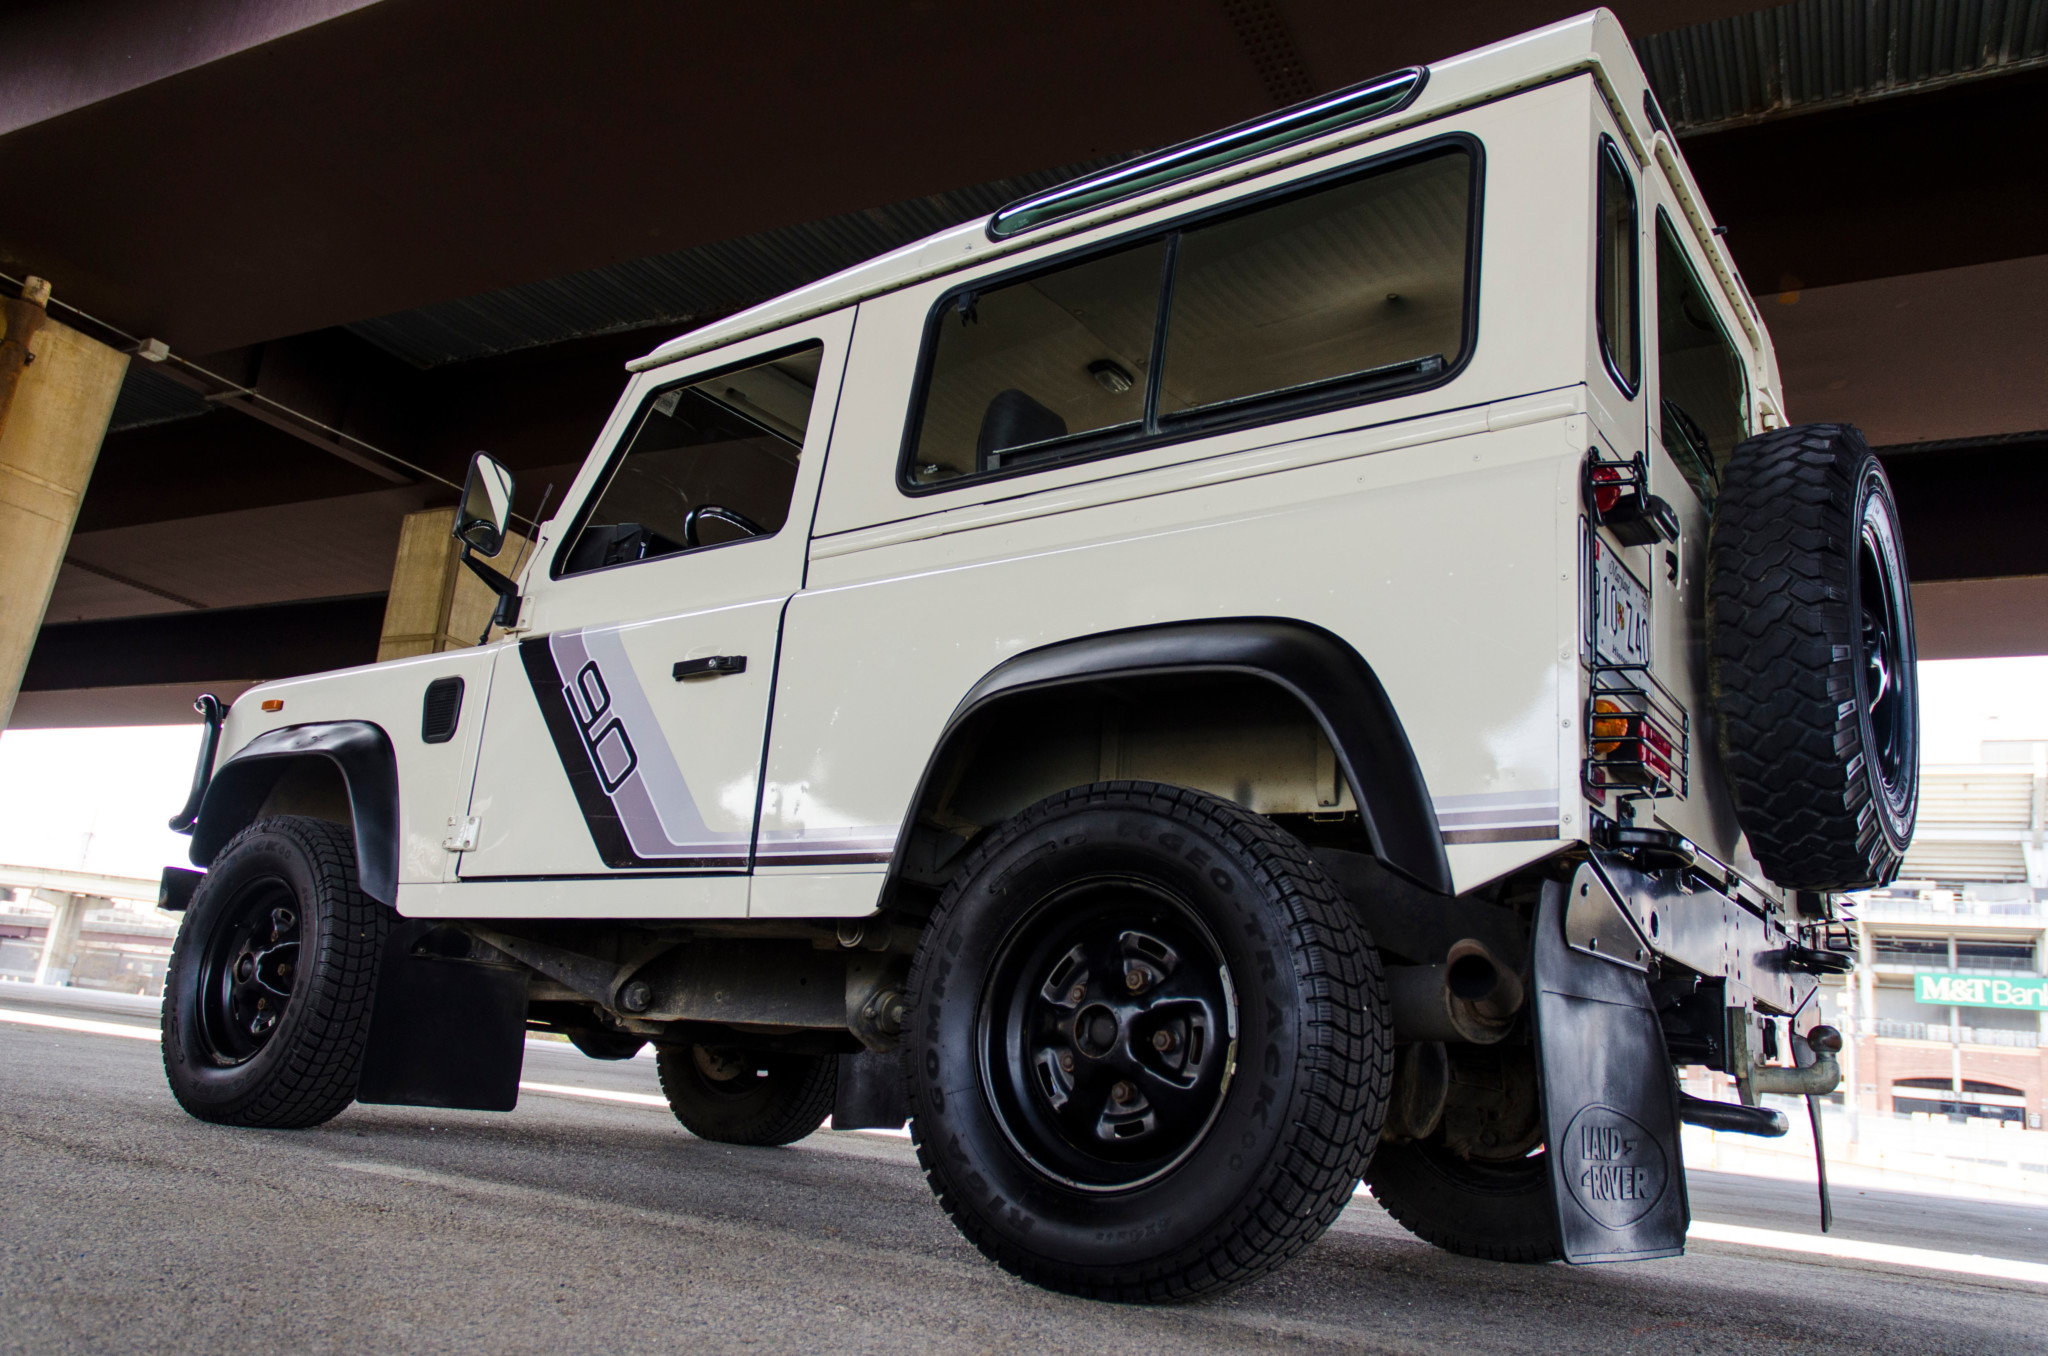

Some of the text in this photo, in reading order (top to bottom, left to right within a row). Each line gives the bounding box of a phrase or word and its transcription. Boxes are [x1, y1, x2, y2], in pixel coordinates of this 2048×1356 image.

[1612, 643, 1630, 664] Histor
[1625, 599, 1649, 667] Z40
[561, 658, 638, 796] 90
[1158, 832, 1284, 1130] GEO-TRACK
[1920, 975, 1992, 1004] M&T
[924, 930, 964, 1116] GOMME
[1581, 1125, 1623, 1161] LAND
[1590, 1165, 1650, 1201] ROVER
